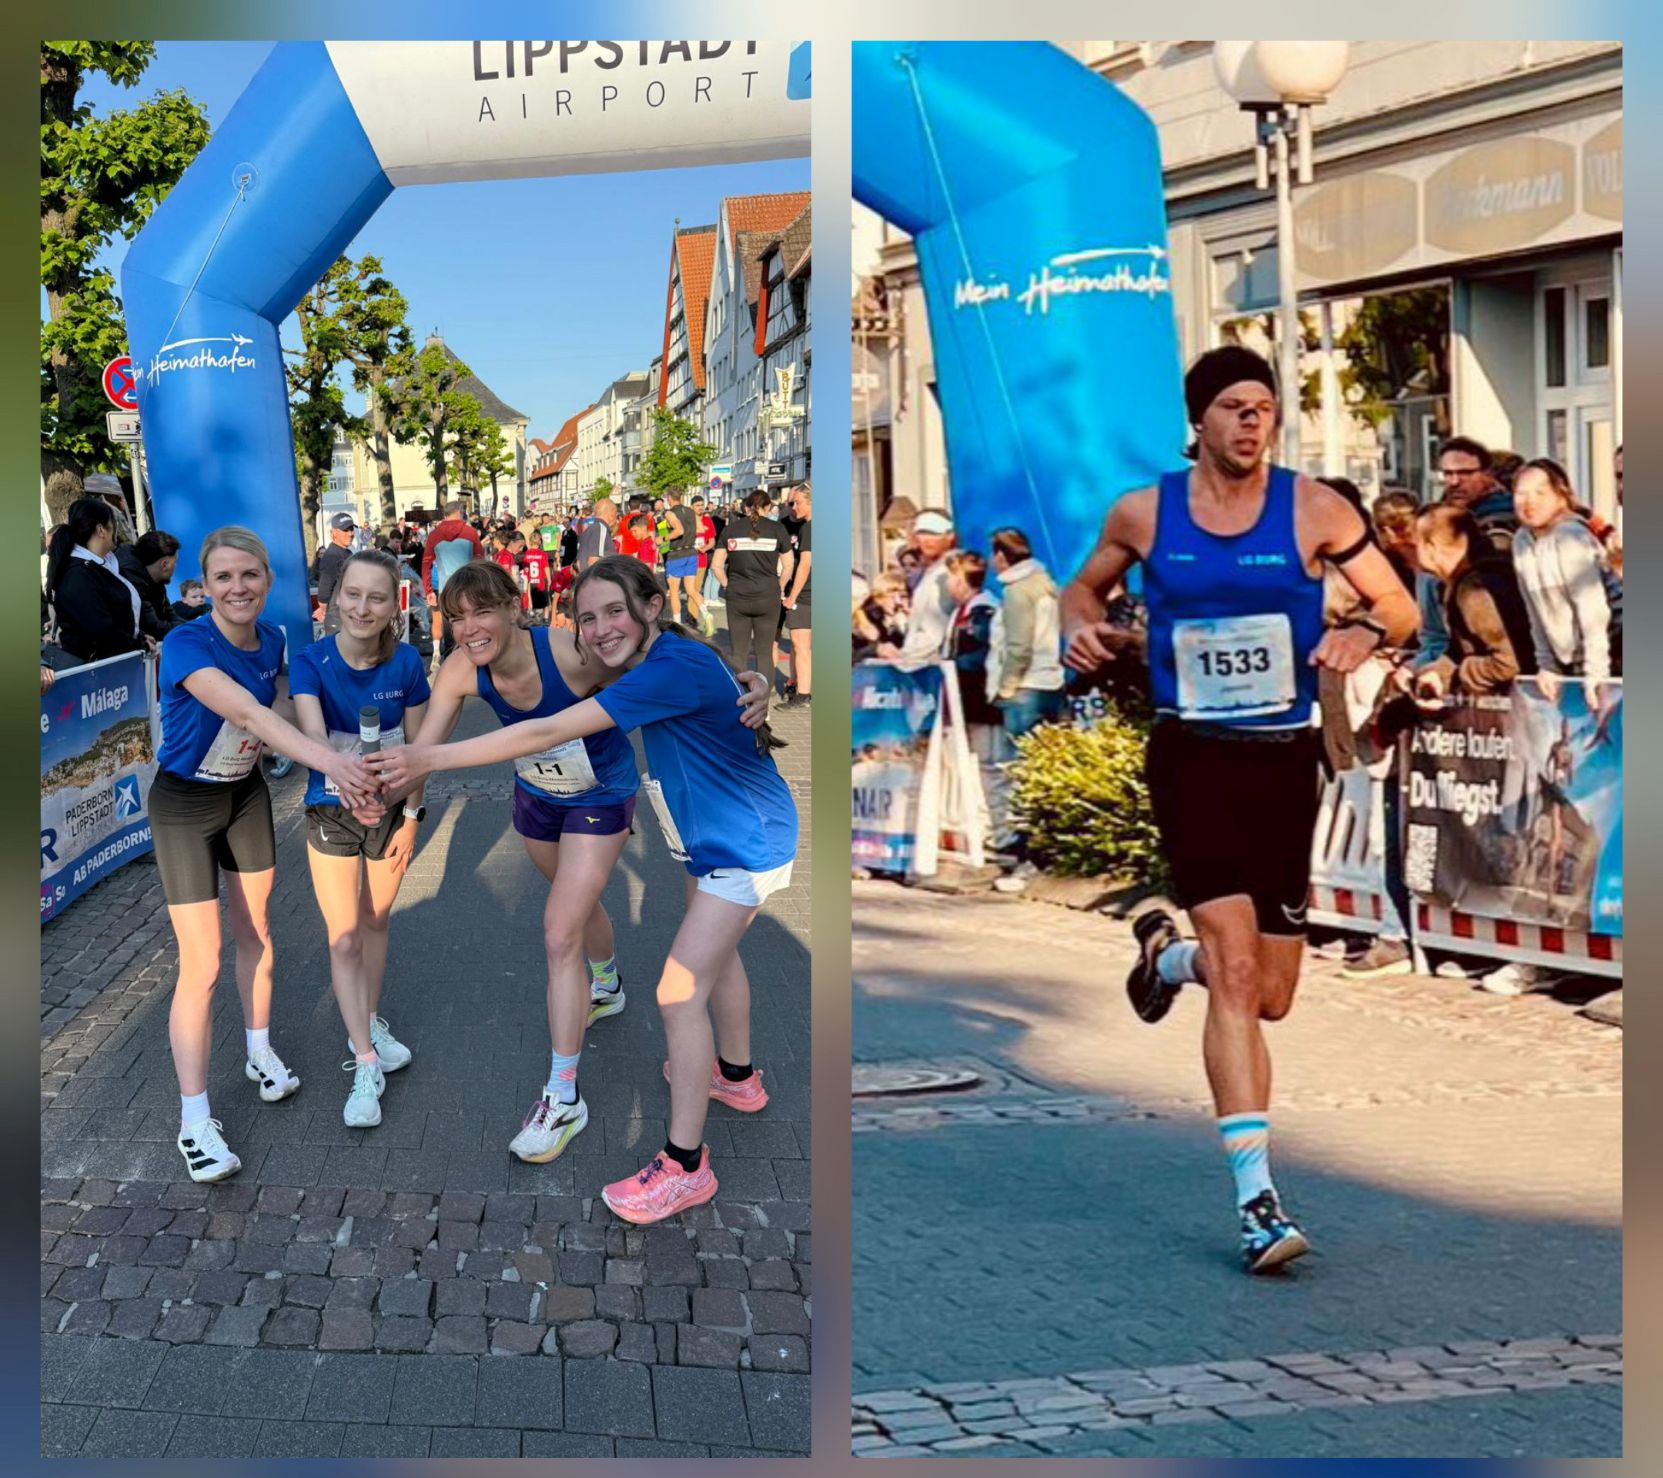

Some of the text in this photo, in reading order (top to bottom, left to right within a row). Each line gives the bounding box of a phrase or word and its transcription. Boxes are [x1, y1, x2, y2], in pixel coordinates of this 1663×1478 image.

[478, 71, 759, 122] AIRPORT
[954, 261, 1169, 316] Mein Heimathafe
[147, 345, 256, 387] Heimathafen
[530, 560, 540, 578] 6
[1197, 647, 1271, 677] 1533
[81, 685, 129, 719] Málaga
[534, 762, 563, 776] 1-1
[65, 786, 114, 825] PADERBORN
[71, 801, 114, 838] LIPPSTADT
[73, 826, 152, 886] AB PADERBORN!
